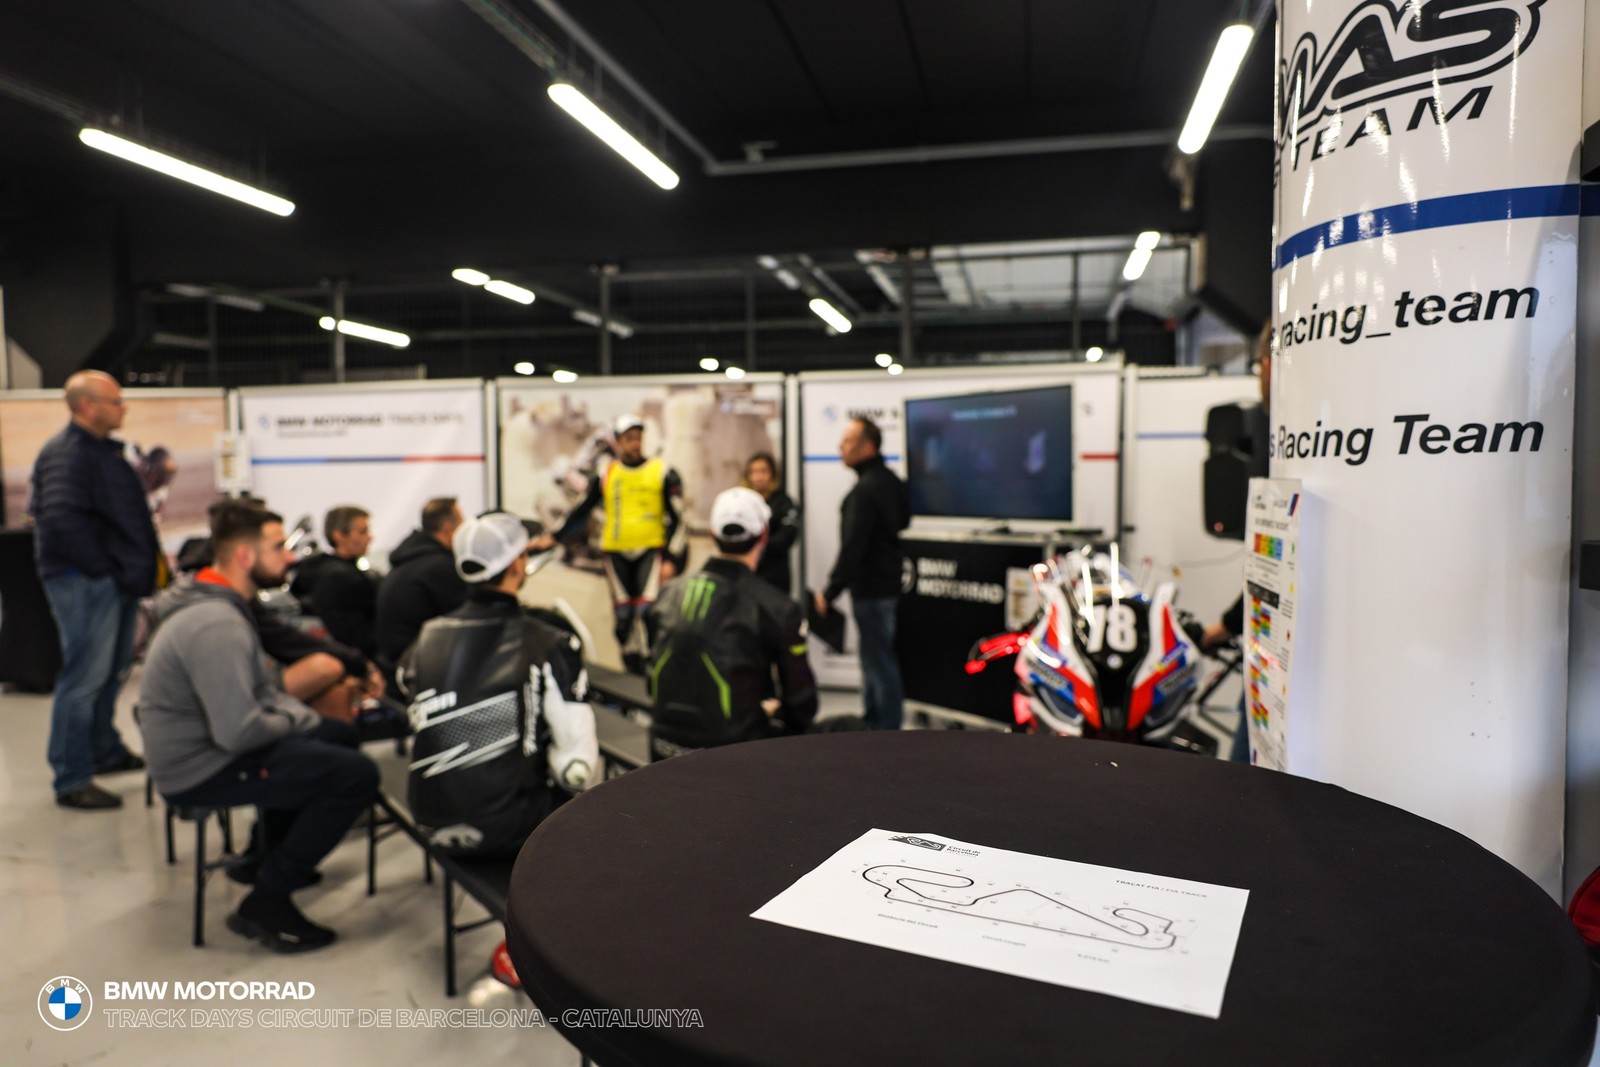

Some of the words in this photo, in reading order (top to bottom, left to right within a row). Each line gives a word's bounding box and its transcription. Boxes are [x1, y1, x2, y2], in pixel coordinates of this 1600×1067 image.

[1292, 85, 1493, 172] TEAM
[1277, 421, 1374, 466] Racing
[1393, 414, 1544, 455] Team
[916, 578, 1004, 605] MOTORRAD
[917, 556, 958, 577] BMW
[1085, 603, 1138, 653] 78
